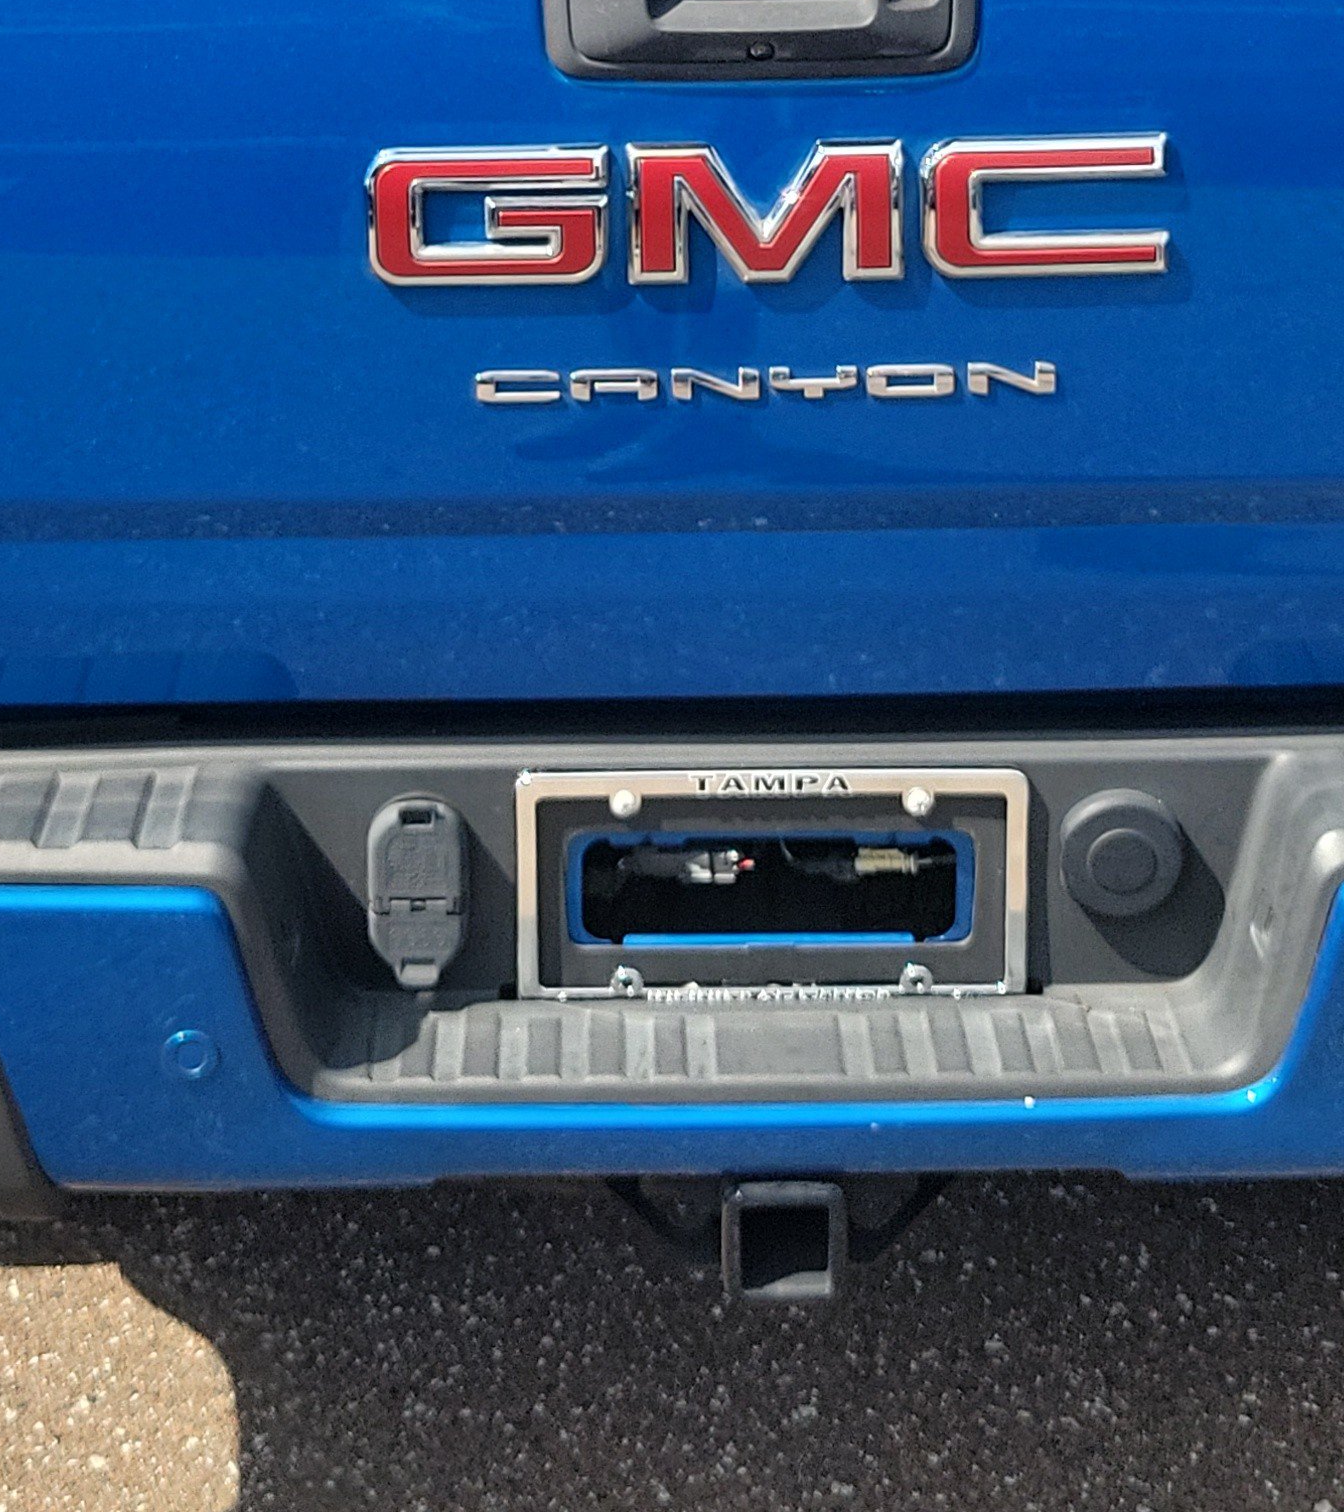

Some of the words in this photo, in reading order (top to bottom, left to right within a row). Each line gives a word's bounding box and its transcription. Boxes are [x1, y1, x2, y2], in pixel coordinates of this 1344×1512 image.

[367, 132, 1169, 285] GMC
[475, 361, 1057, 403] CANYON
[689, 773, 853, 796] TAMPA
